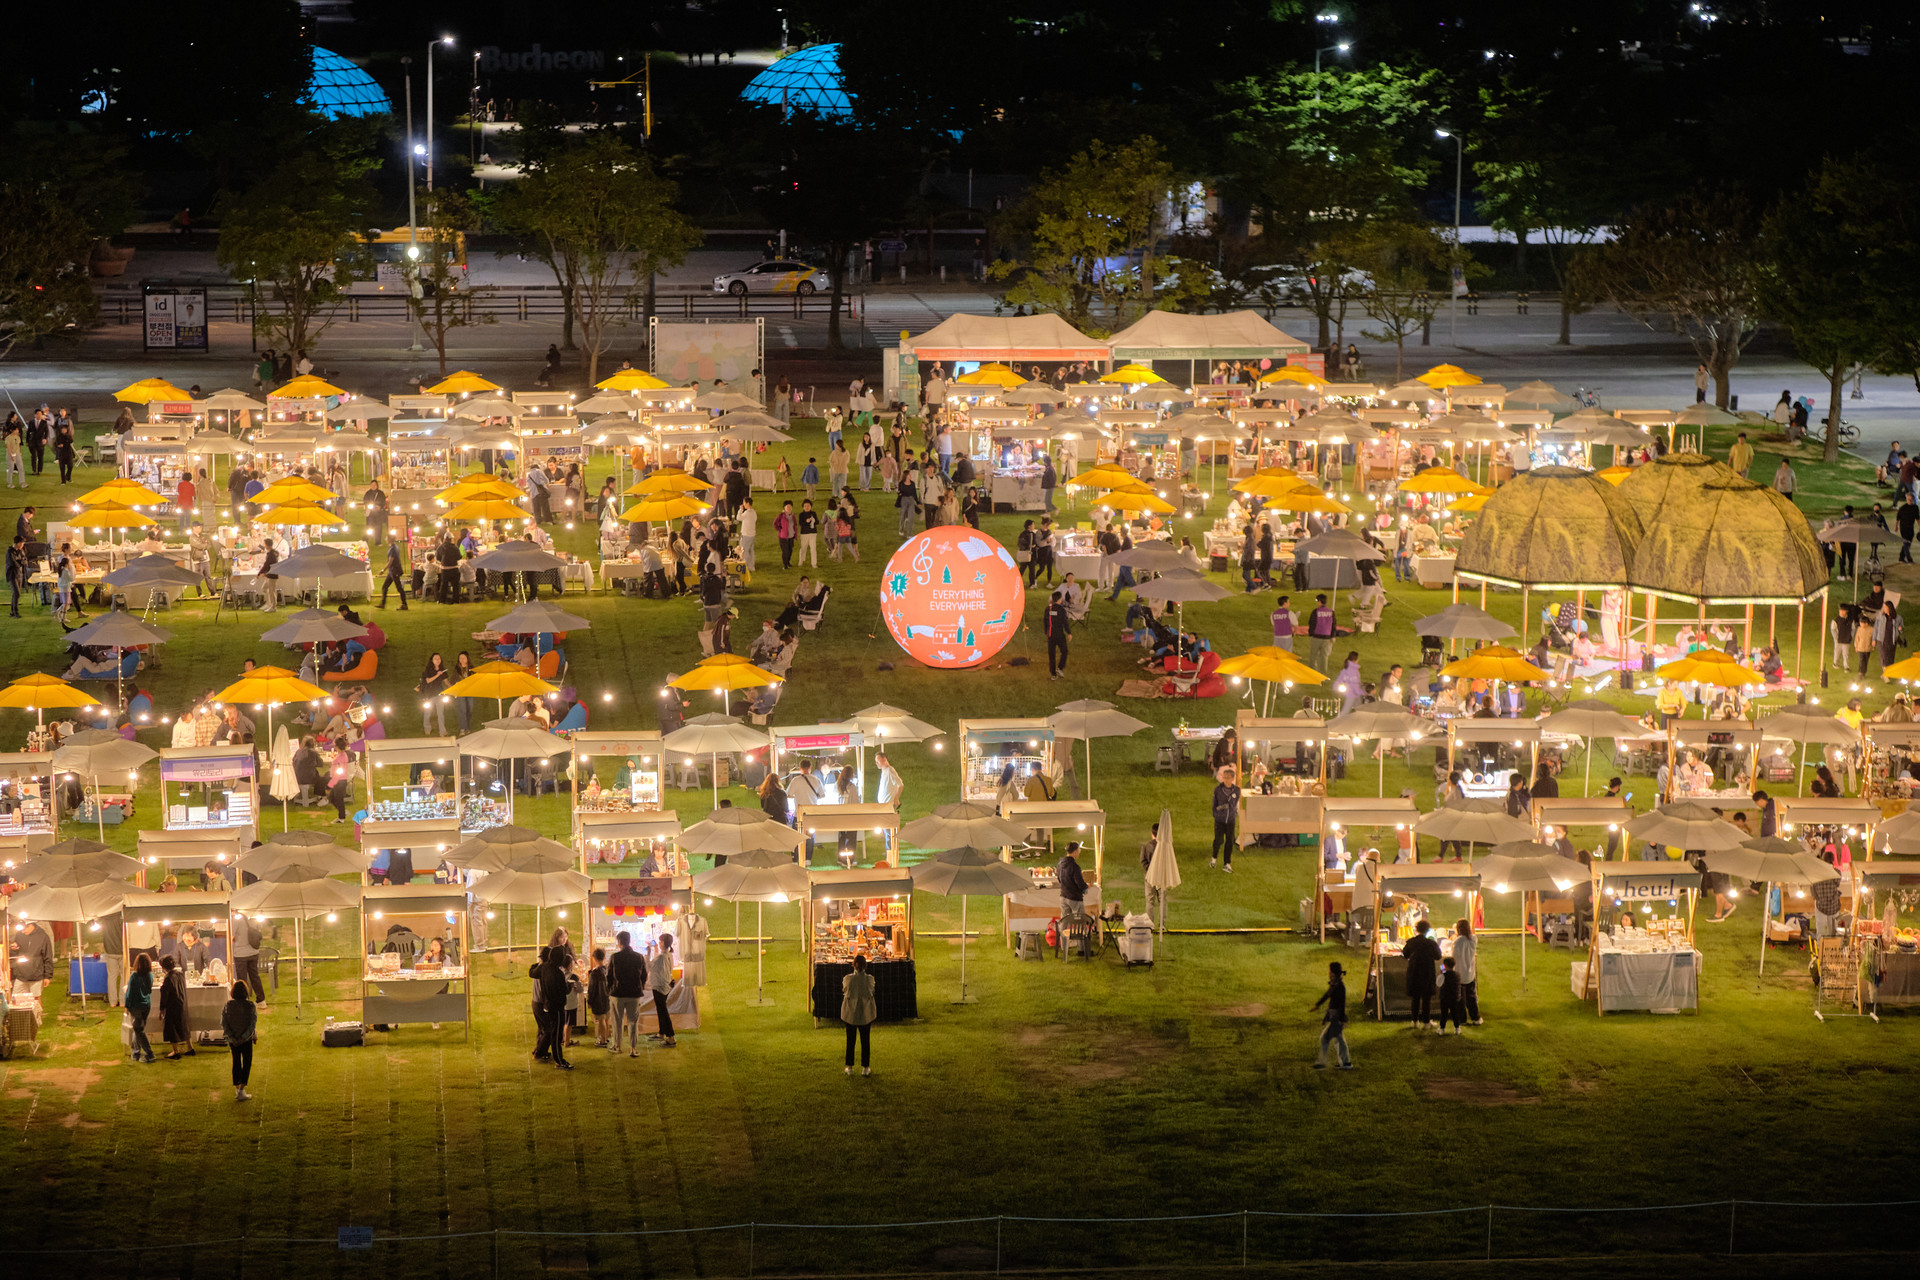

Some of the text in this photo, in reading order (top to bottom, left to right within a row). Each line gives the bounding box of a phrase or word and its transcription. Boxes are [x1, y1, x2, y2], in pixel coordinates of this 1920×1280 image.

[932, 589, 984, 600] EVERYTHING
[929, 600, 987, 611] EVERYWHERE
[1623, 878, 1675, 898] heu:l
